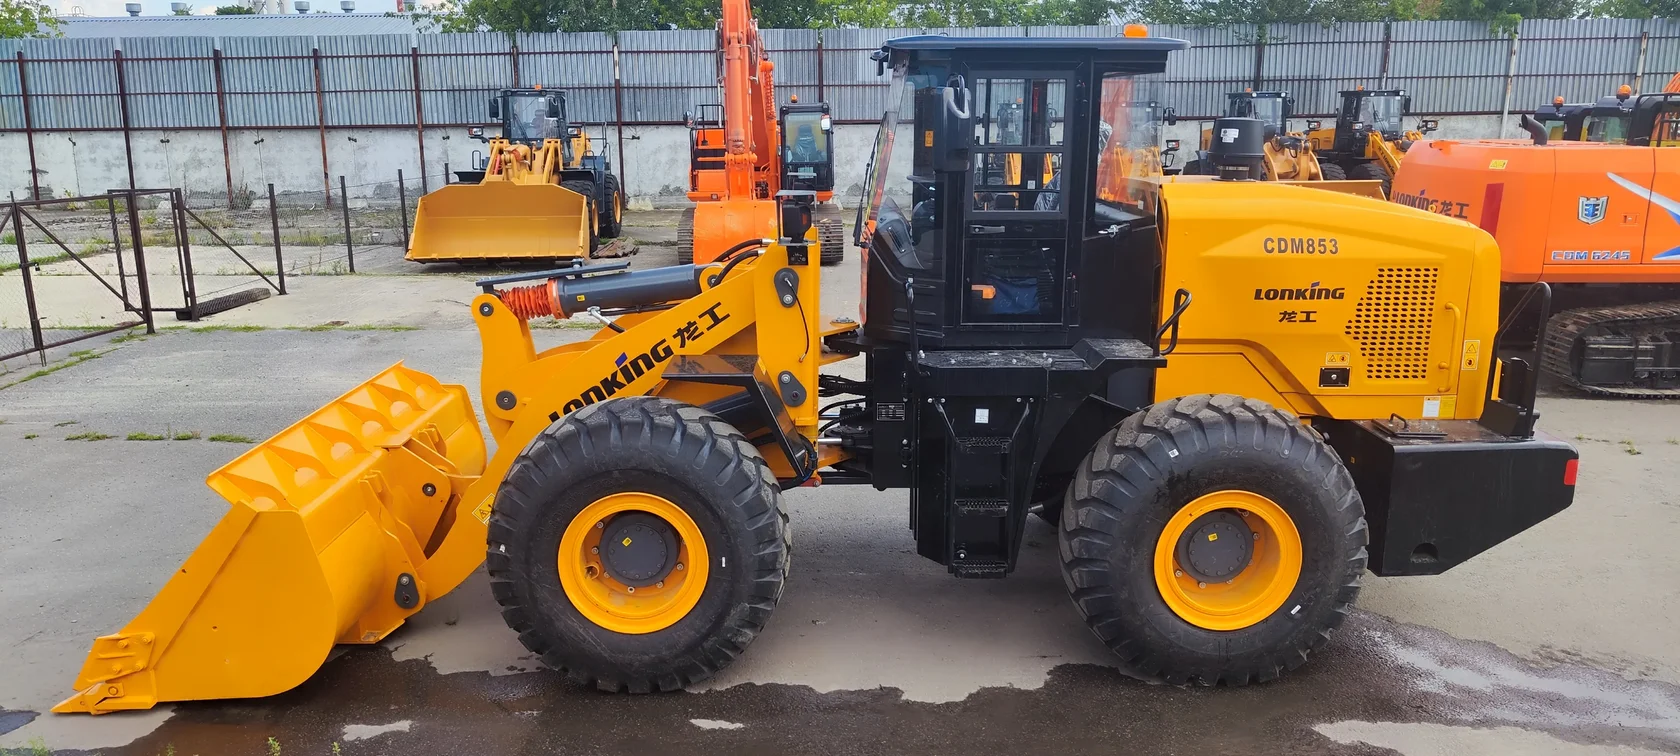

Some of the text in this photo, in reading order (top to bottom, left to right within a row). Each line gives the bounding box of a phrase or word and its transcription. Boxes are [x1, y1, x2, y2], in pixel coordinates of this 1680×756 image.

[1263, 237, 1339, 254] CDM853
[1551, 250, 1631, 261] CDM 6245
[1254, 281, 1345, 300] LONKING
[672, 302, 731, 348] 龙工
[1278, 310, 1317, 323] 龙工
